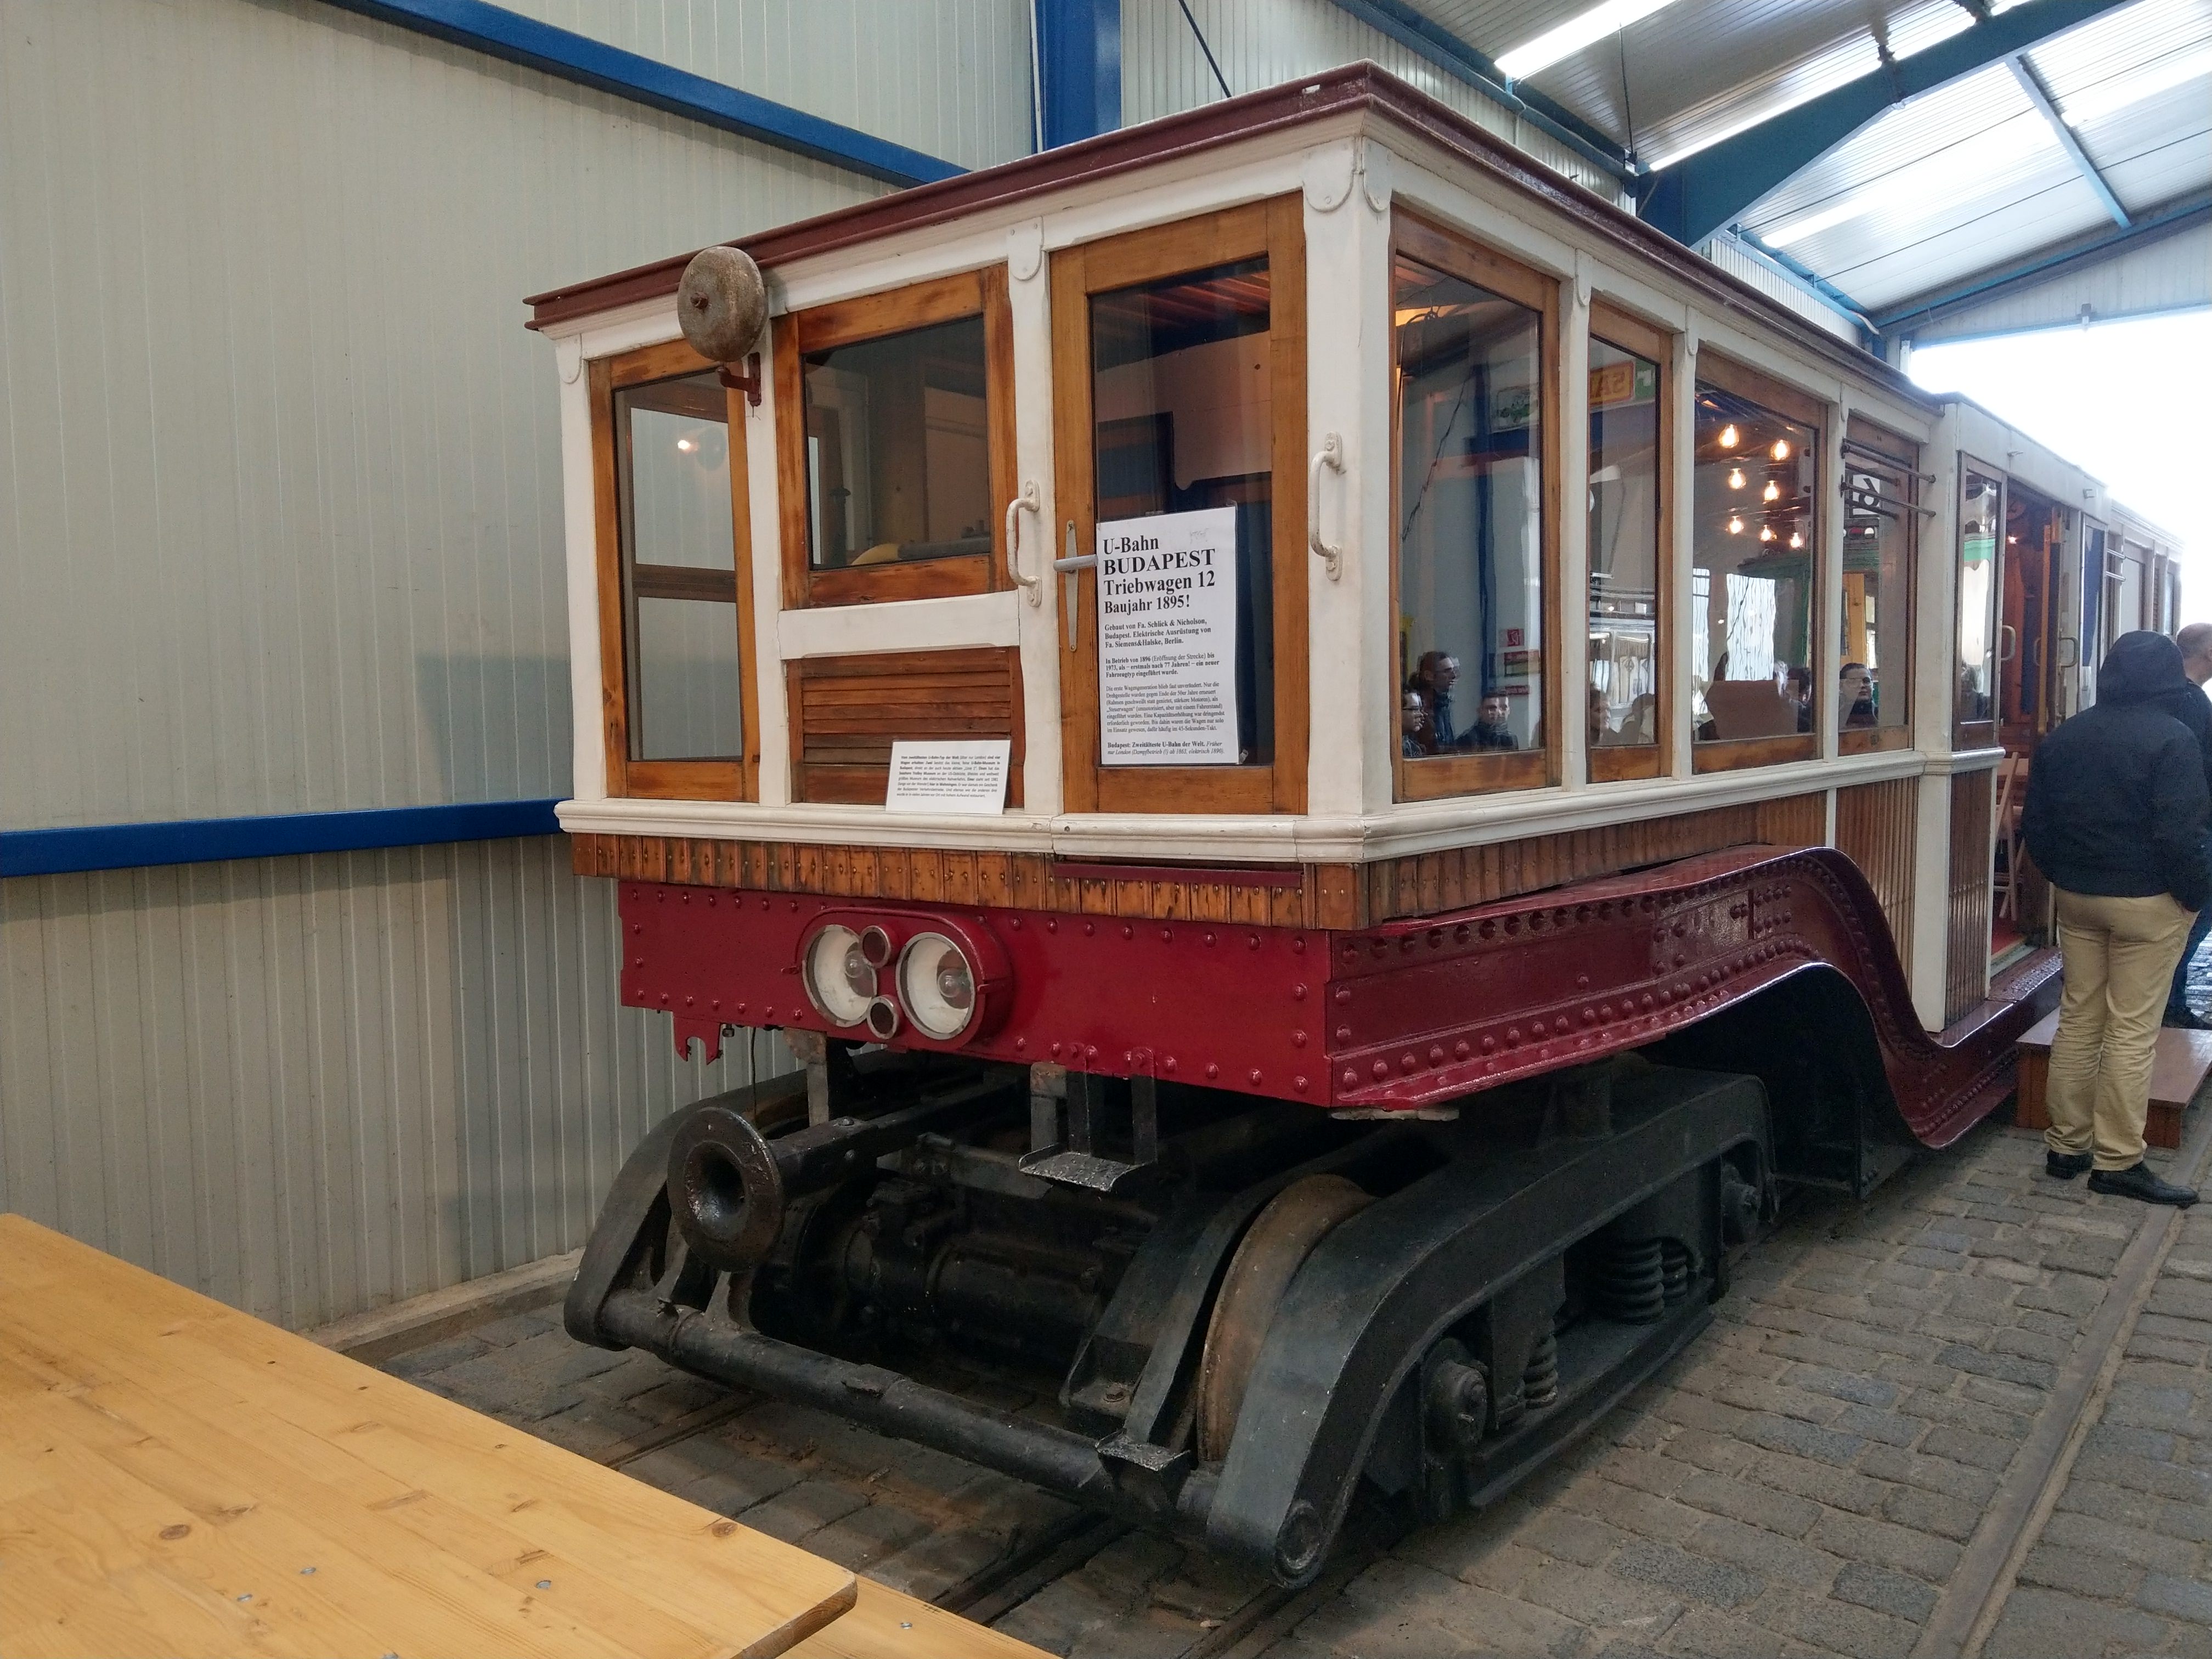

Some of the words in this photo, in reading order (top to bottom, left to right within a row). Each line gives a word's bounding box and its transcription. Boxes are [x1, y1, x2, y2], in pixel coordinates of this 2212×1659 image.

[1104, 535, 1159, 555] U-Bahn
[1103, 548, 1215, 575] BUDAPEST
[1103, 577, 1192, 595] Triebwagen
[1199, 570, 1215, 587] 12
[1104, 598, 1152, 616] Baujahr
[1156, 594, 1189, 610] 1895!
[1177, 618, 1207, 626] Nicholson,
[1105, 632, 1131, 640] Budapest.
[1133, 629, 1164, 637] Elektrische
